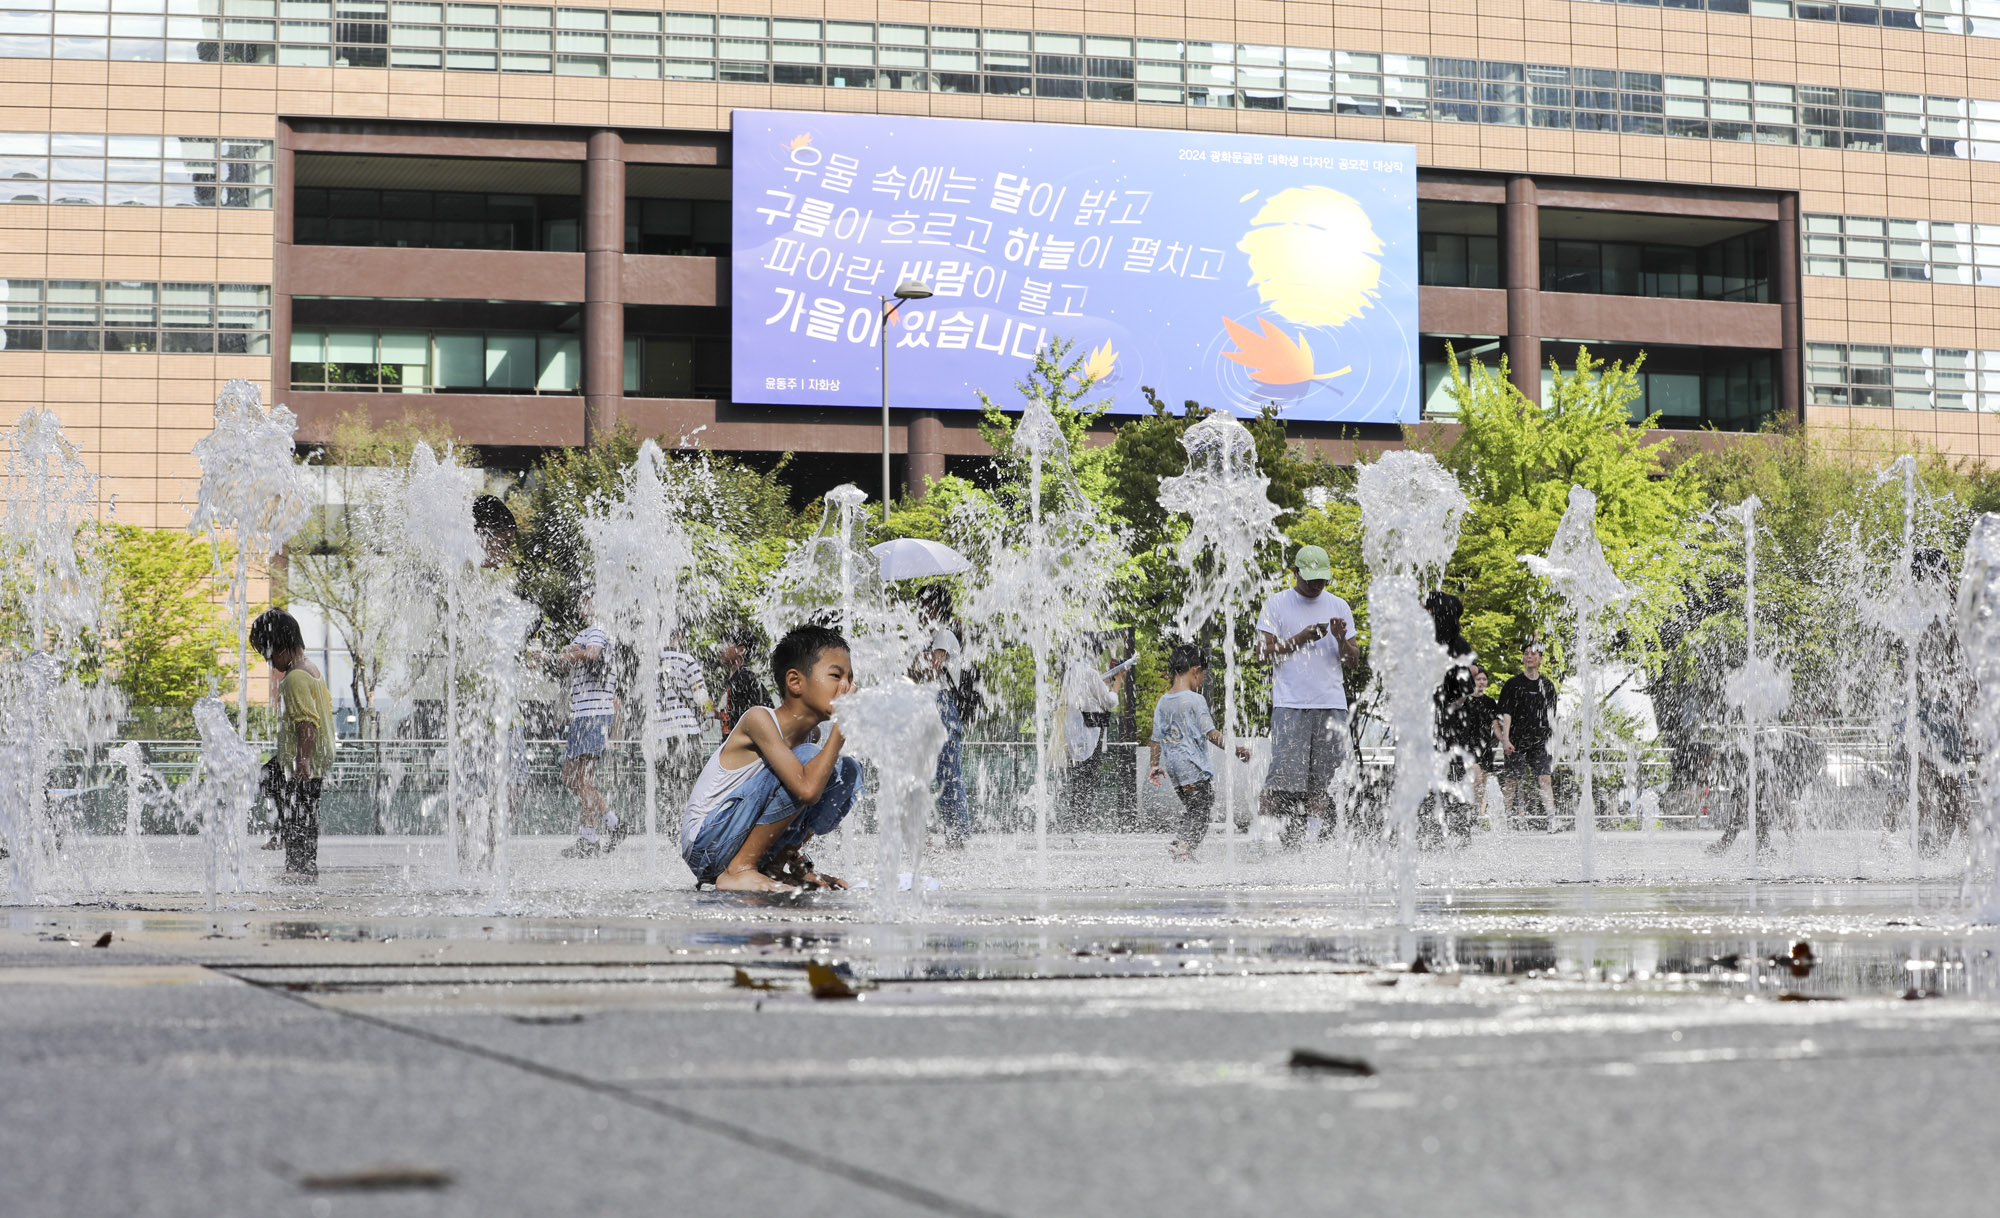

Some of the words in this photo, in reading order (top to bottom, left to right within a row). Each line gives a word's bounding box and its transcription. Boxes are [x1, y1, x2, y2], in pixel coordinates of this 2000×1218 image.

[784, 146, 859, 193] 우물
[872, 165, 977, 203] 속에는
[990, 171, 1067, 222] 달이
[1074, 189, 1153, 226] 밝고
[1178, 149, 1206, 160] 2024
[1210, 150, 1263, 165] 광화문글판
[1268, 154, 1298, 168] 대학생
[1303, 156, 1334, 169] 디자인
[1338, 158, 1368, 171] 공모전
[1373, 160, 1404, 173] 대상작
[756, 189, 873, 244] 구름이
[880, 210, 993, 254] 흐르고
[1004, 227, 1114, 270] 하늘이
[1123, 236, 1226, 280] 펼치고
[763, 237, 885, 295] 파아란
[1018, 276, 1089, 317] 불고
[765, 287, 884, 348] 가을이
[765, 377, 798, 390] 윤동주
[808, 379, 841, 392] 자화상
